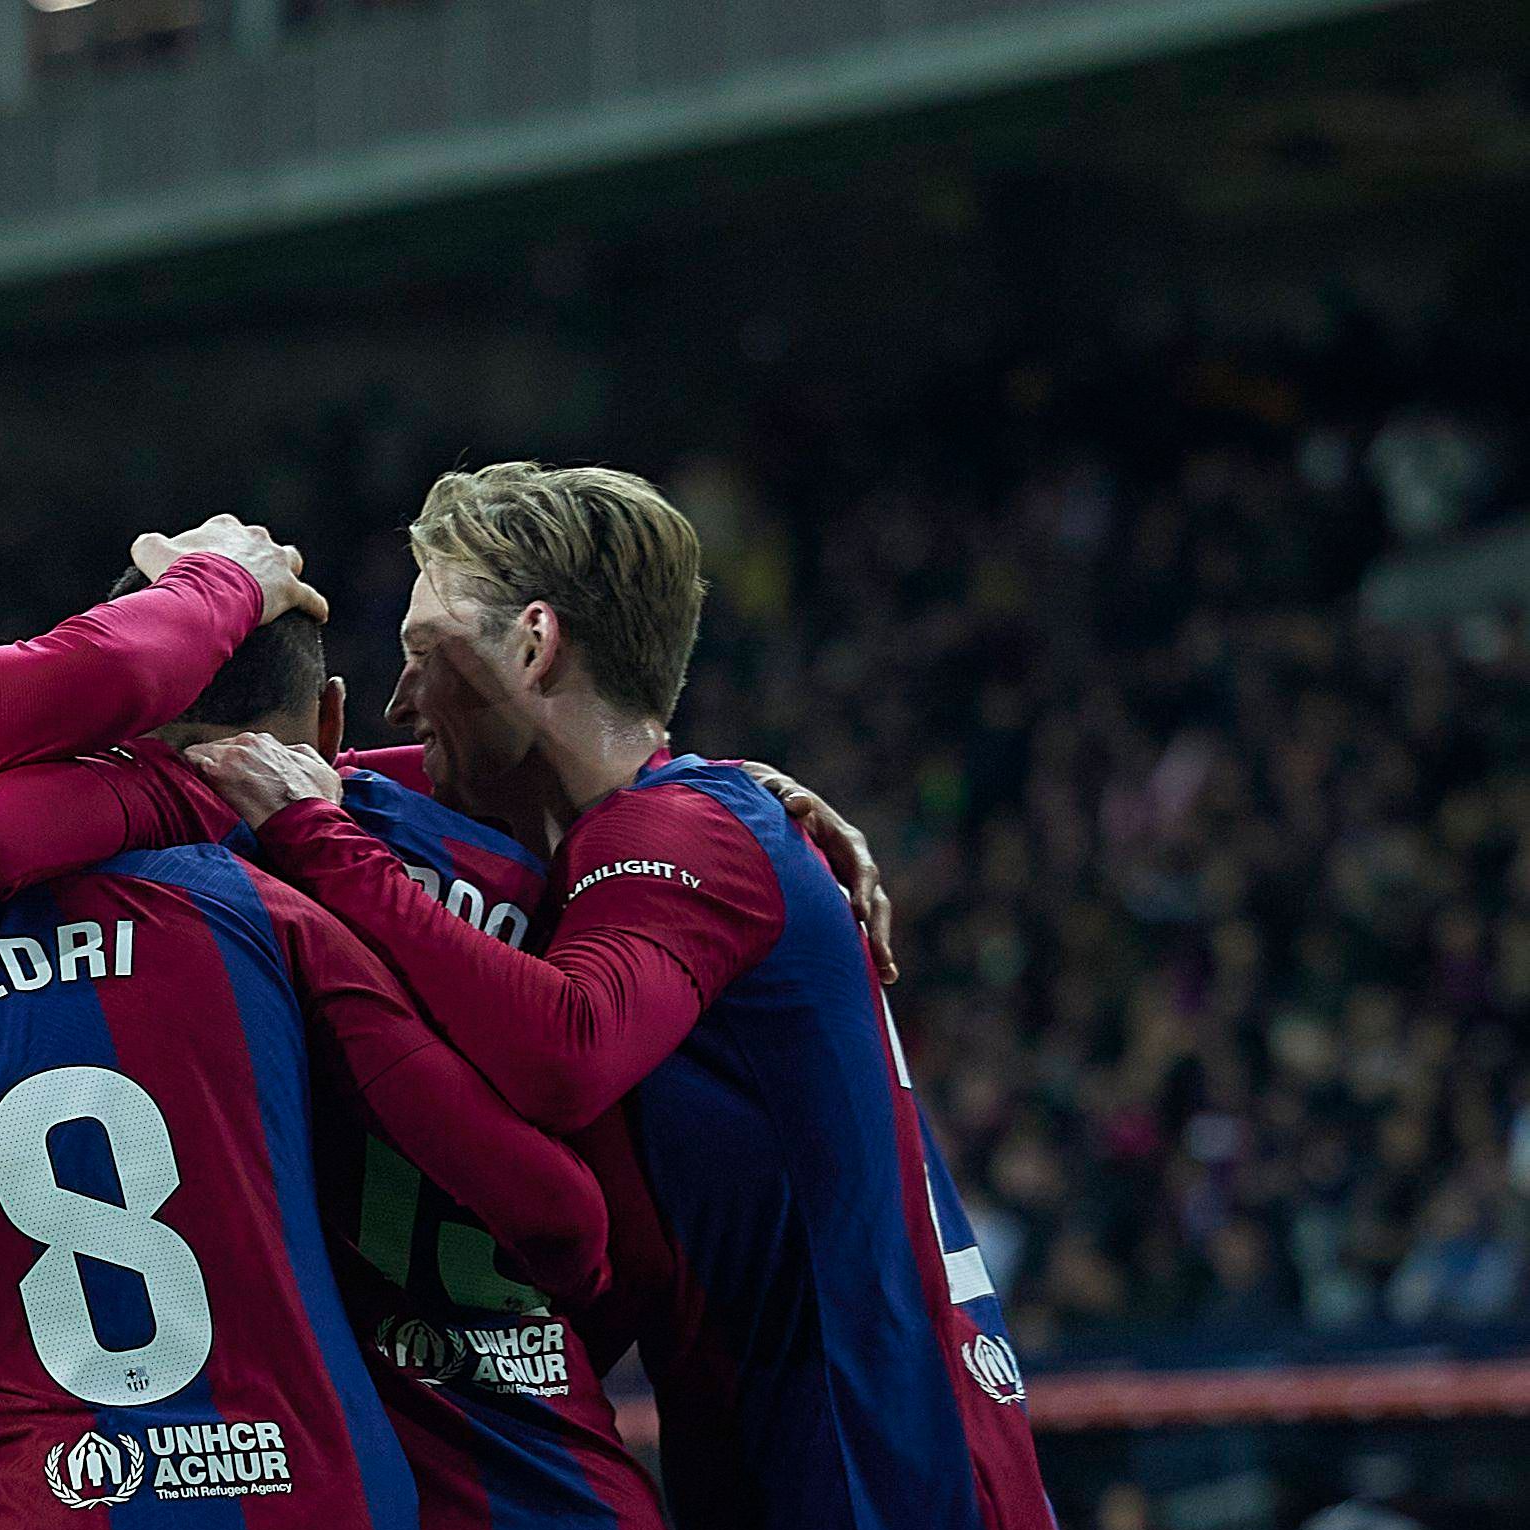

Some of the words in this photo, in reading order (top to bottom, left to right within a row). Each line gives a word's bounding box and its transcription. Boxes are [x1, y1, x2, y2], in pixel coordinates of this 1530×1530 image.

[563, 860, 676, 908] MBILIGHT
[680, 870, 702, 889] tv
[464, 1323, 565, 1357] UNHCR
[471, 1353, 569, 1385] ACNUR
[147, 1422, 285, 1456] UNHCR
[153, 1451, 291, 1487] ACNUR
[156, 1488, 179, 1500] The
[181, 1486, 199, 1499] UN
[200, 1485, 249, 1498] Refugee
[250, 1482, 293, 1494] Agency
